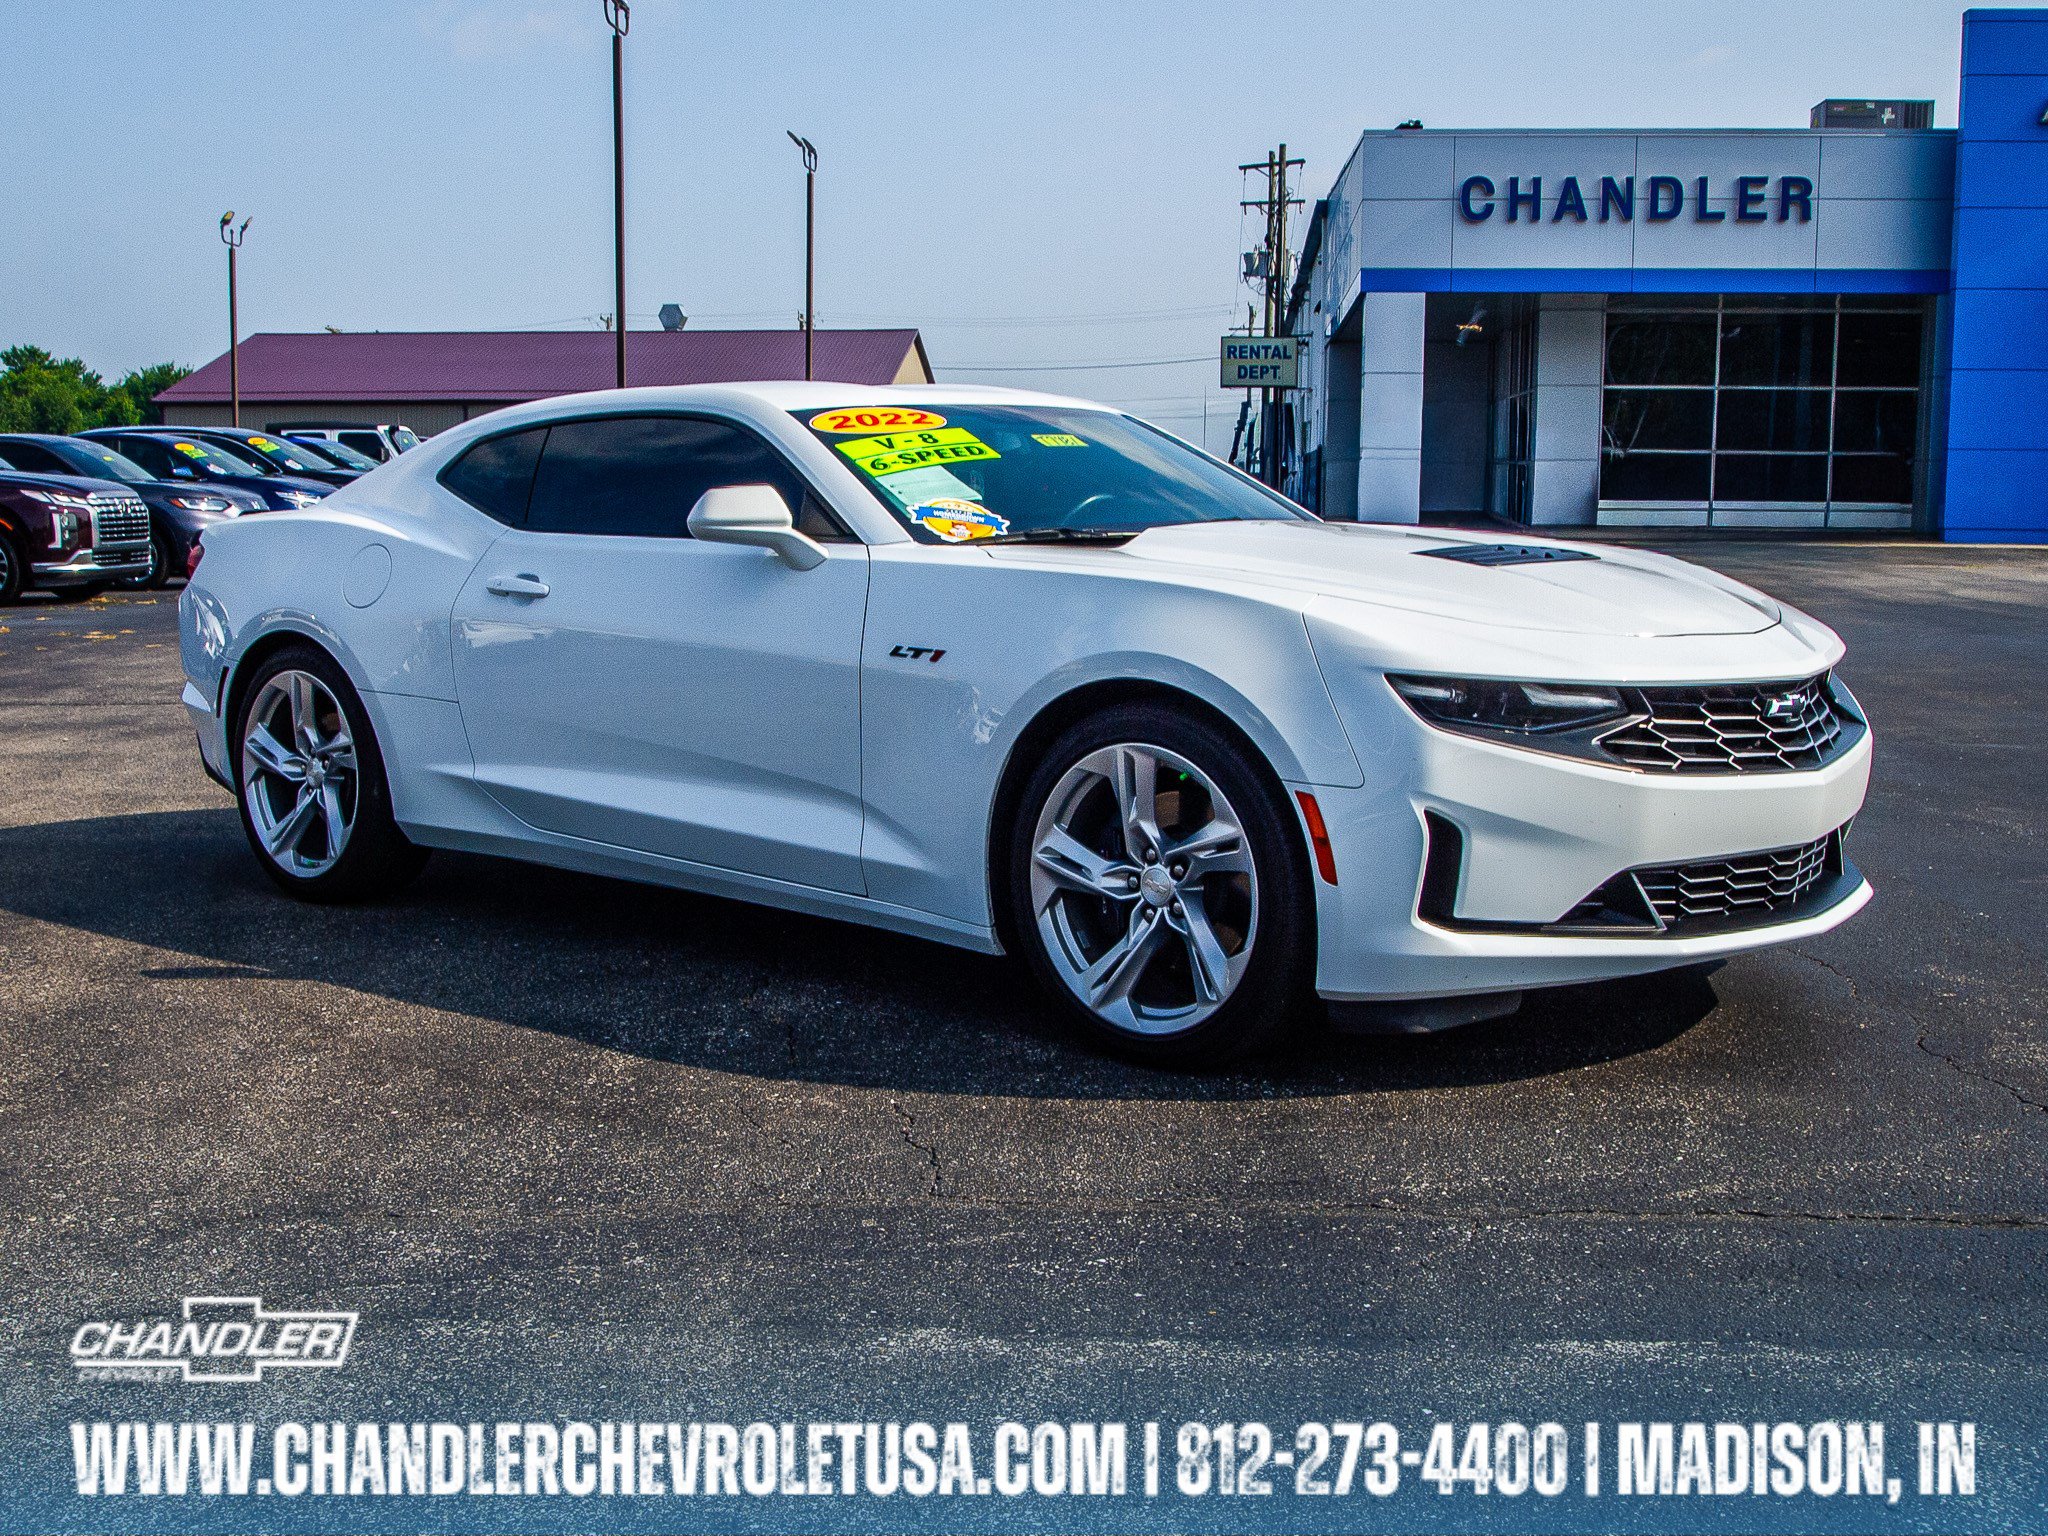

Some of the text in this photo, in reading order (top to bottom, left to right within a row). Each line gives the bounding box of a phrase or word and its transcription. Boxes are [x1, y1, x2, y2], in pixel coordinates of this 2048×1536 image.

[1459, 174, 1814, 223] CHANDLER
[1226, 344, 1292, 360] RENTAL
[828, 412, 934, 430] 2022
[870, 446, 986, 471] 6-SPEED
